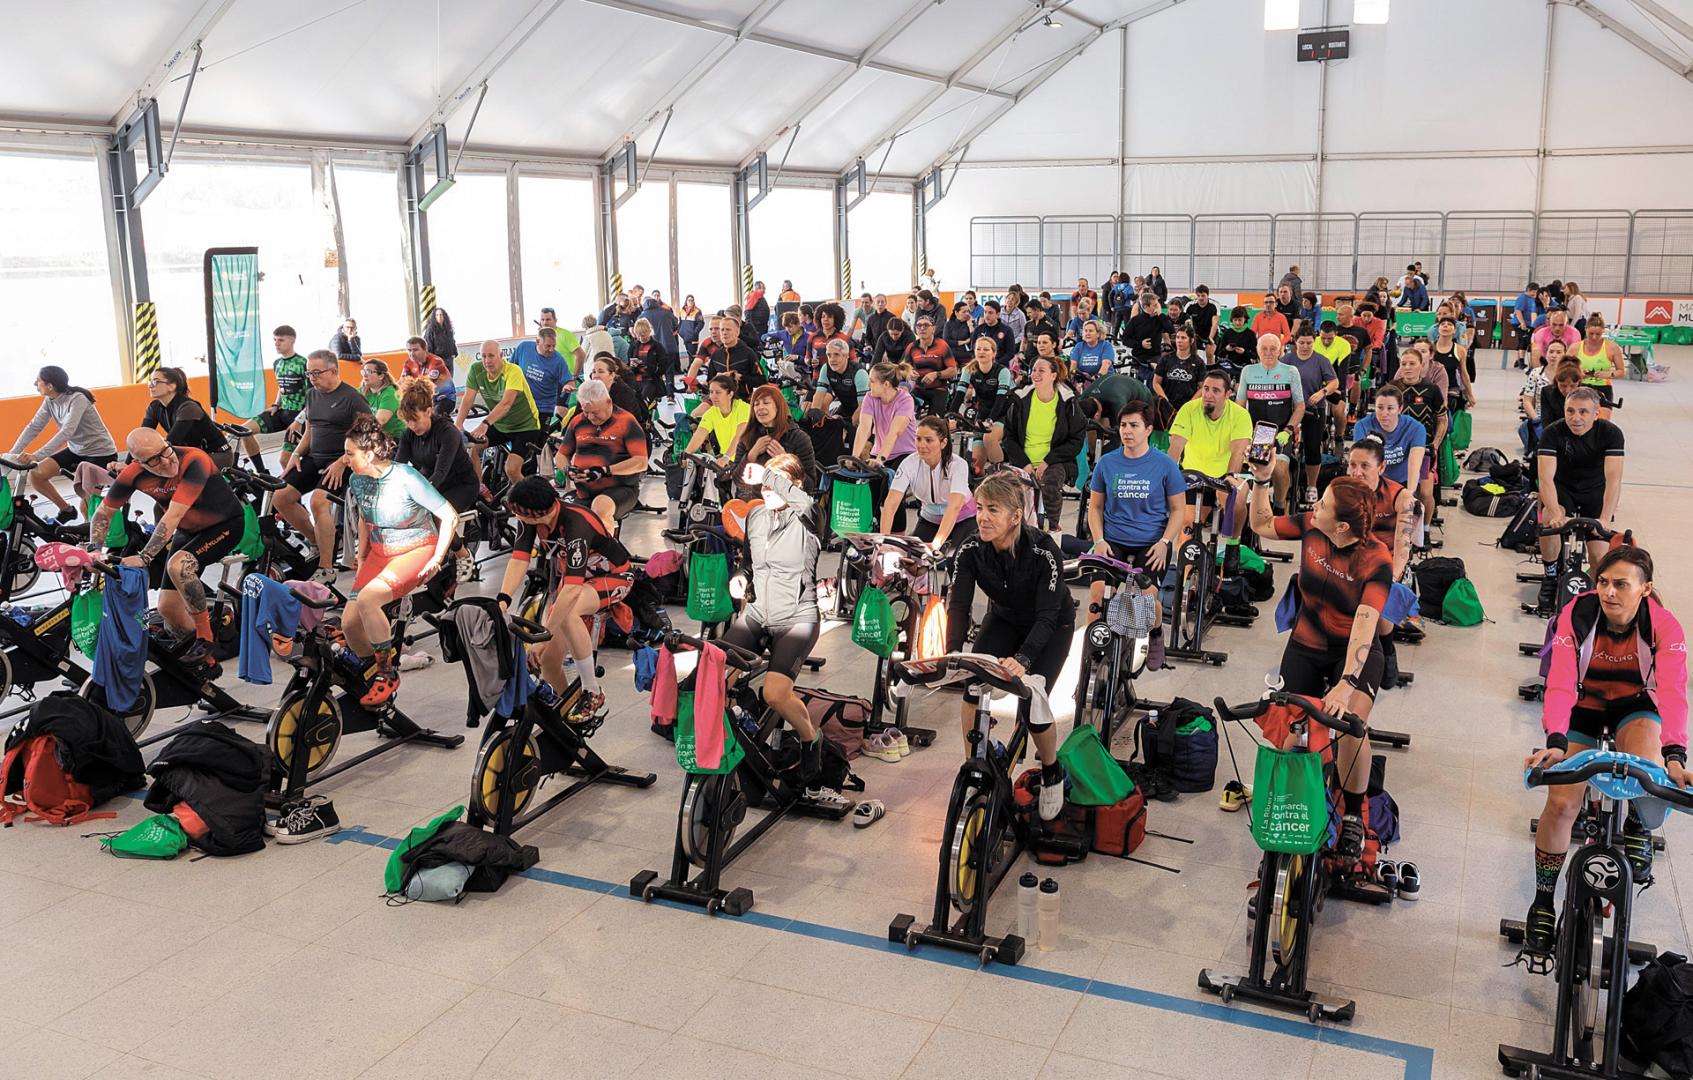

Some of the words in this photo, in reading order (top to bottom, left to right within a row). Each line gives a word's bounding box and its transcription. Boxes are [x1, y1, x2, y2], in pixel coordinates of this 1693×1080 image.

[1118, 491, 1150, 499] cáncer
[1281, 803, 1309, 812] marcha
[1301, 811, 1309, 821] el
[1270, 820, 1310, 832] cáncer
